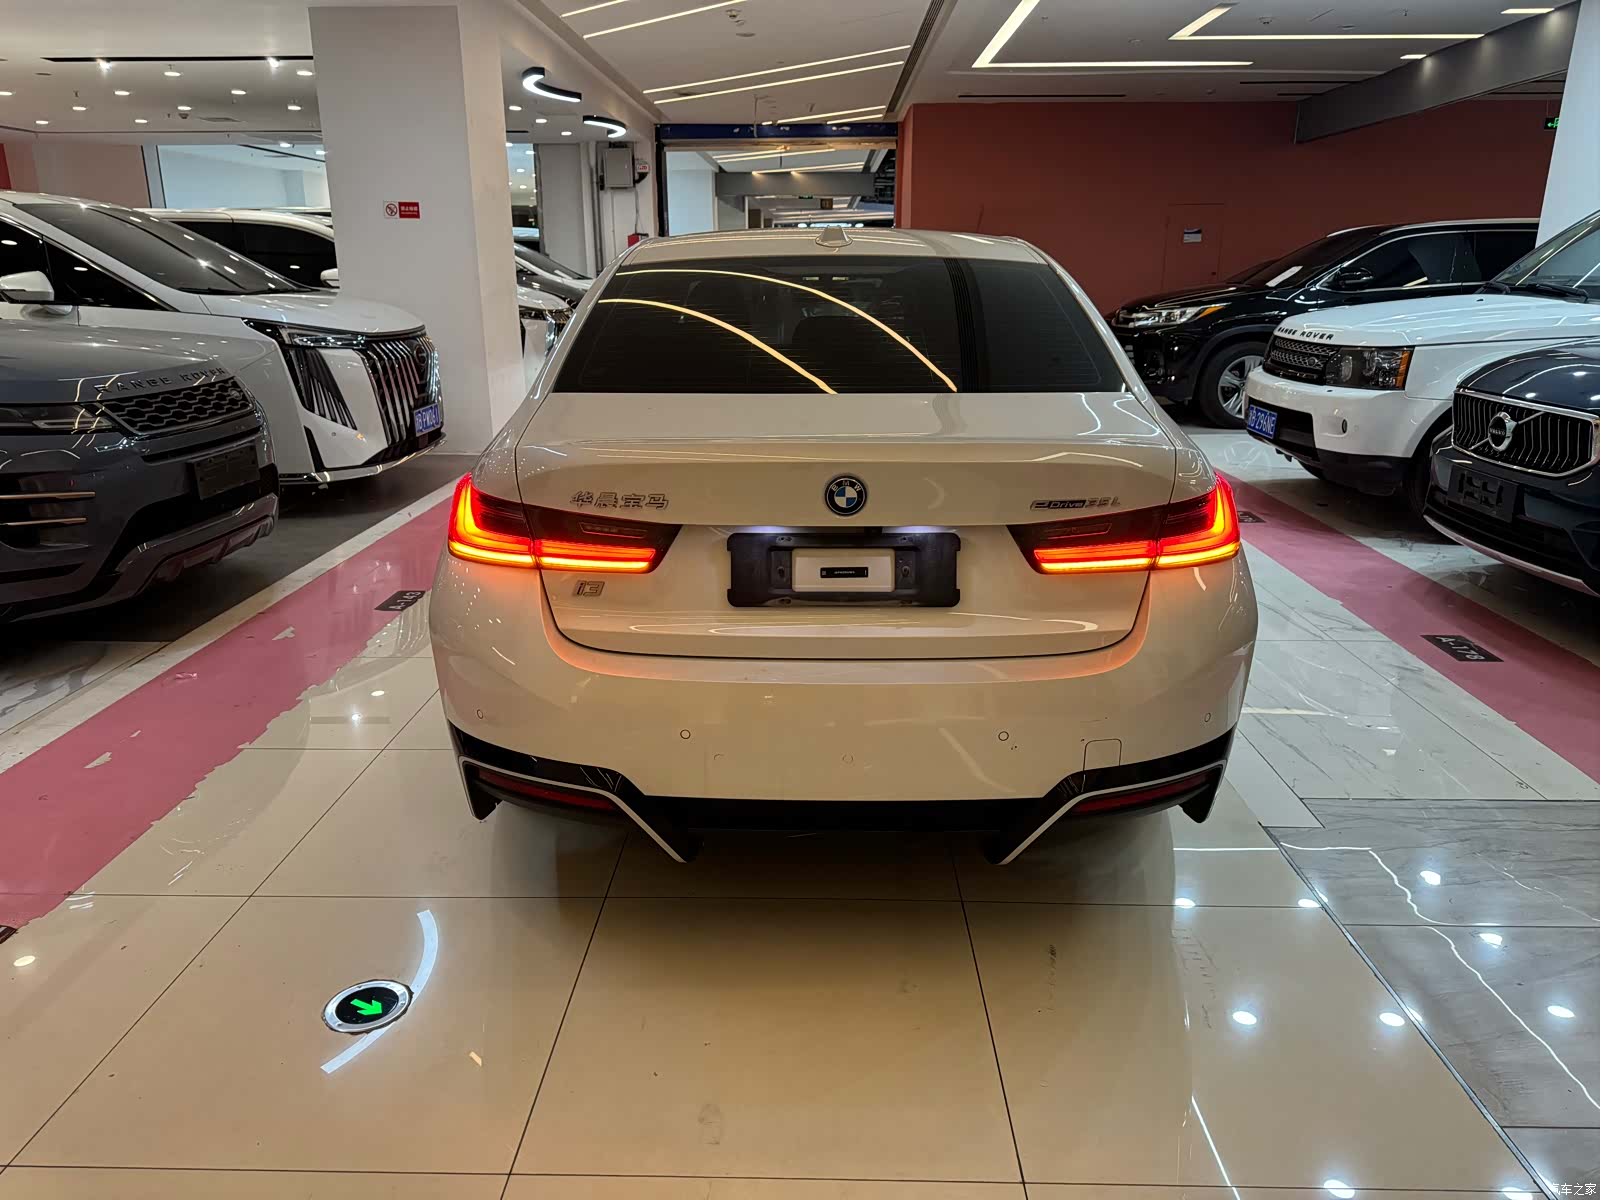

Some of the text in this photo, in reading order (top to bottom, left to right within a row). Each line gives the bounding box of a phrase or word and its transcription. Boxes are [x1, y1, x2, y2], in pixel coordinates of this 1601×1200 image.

[1299, 331, 1335, 341] ROVER
[831, 480, 862, 492] BMW
[570, 491, 669, 510] 华晨宝马
[572, 579, 605, 597] i3
[388, 592, 422, 610] A-143
[1435, 636, 1486, 660] A-178
